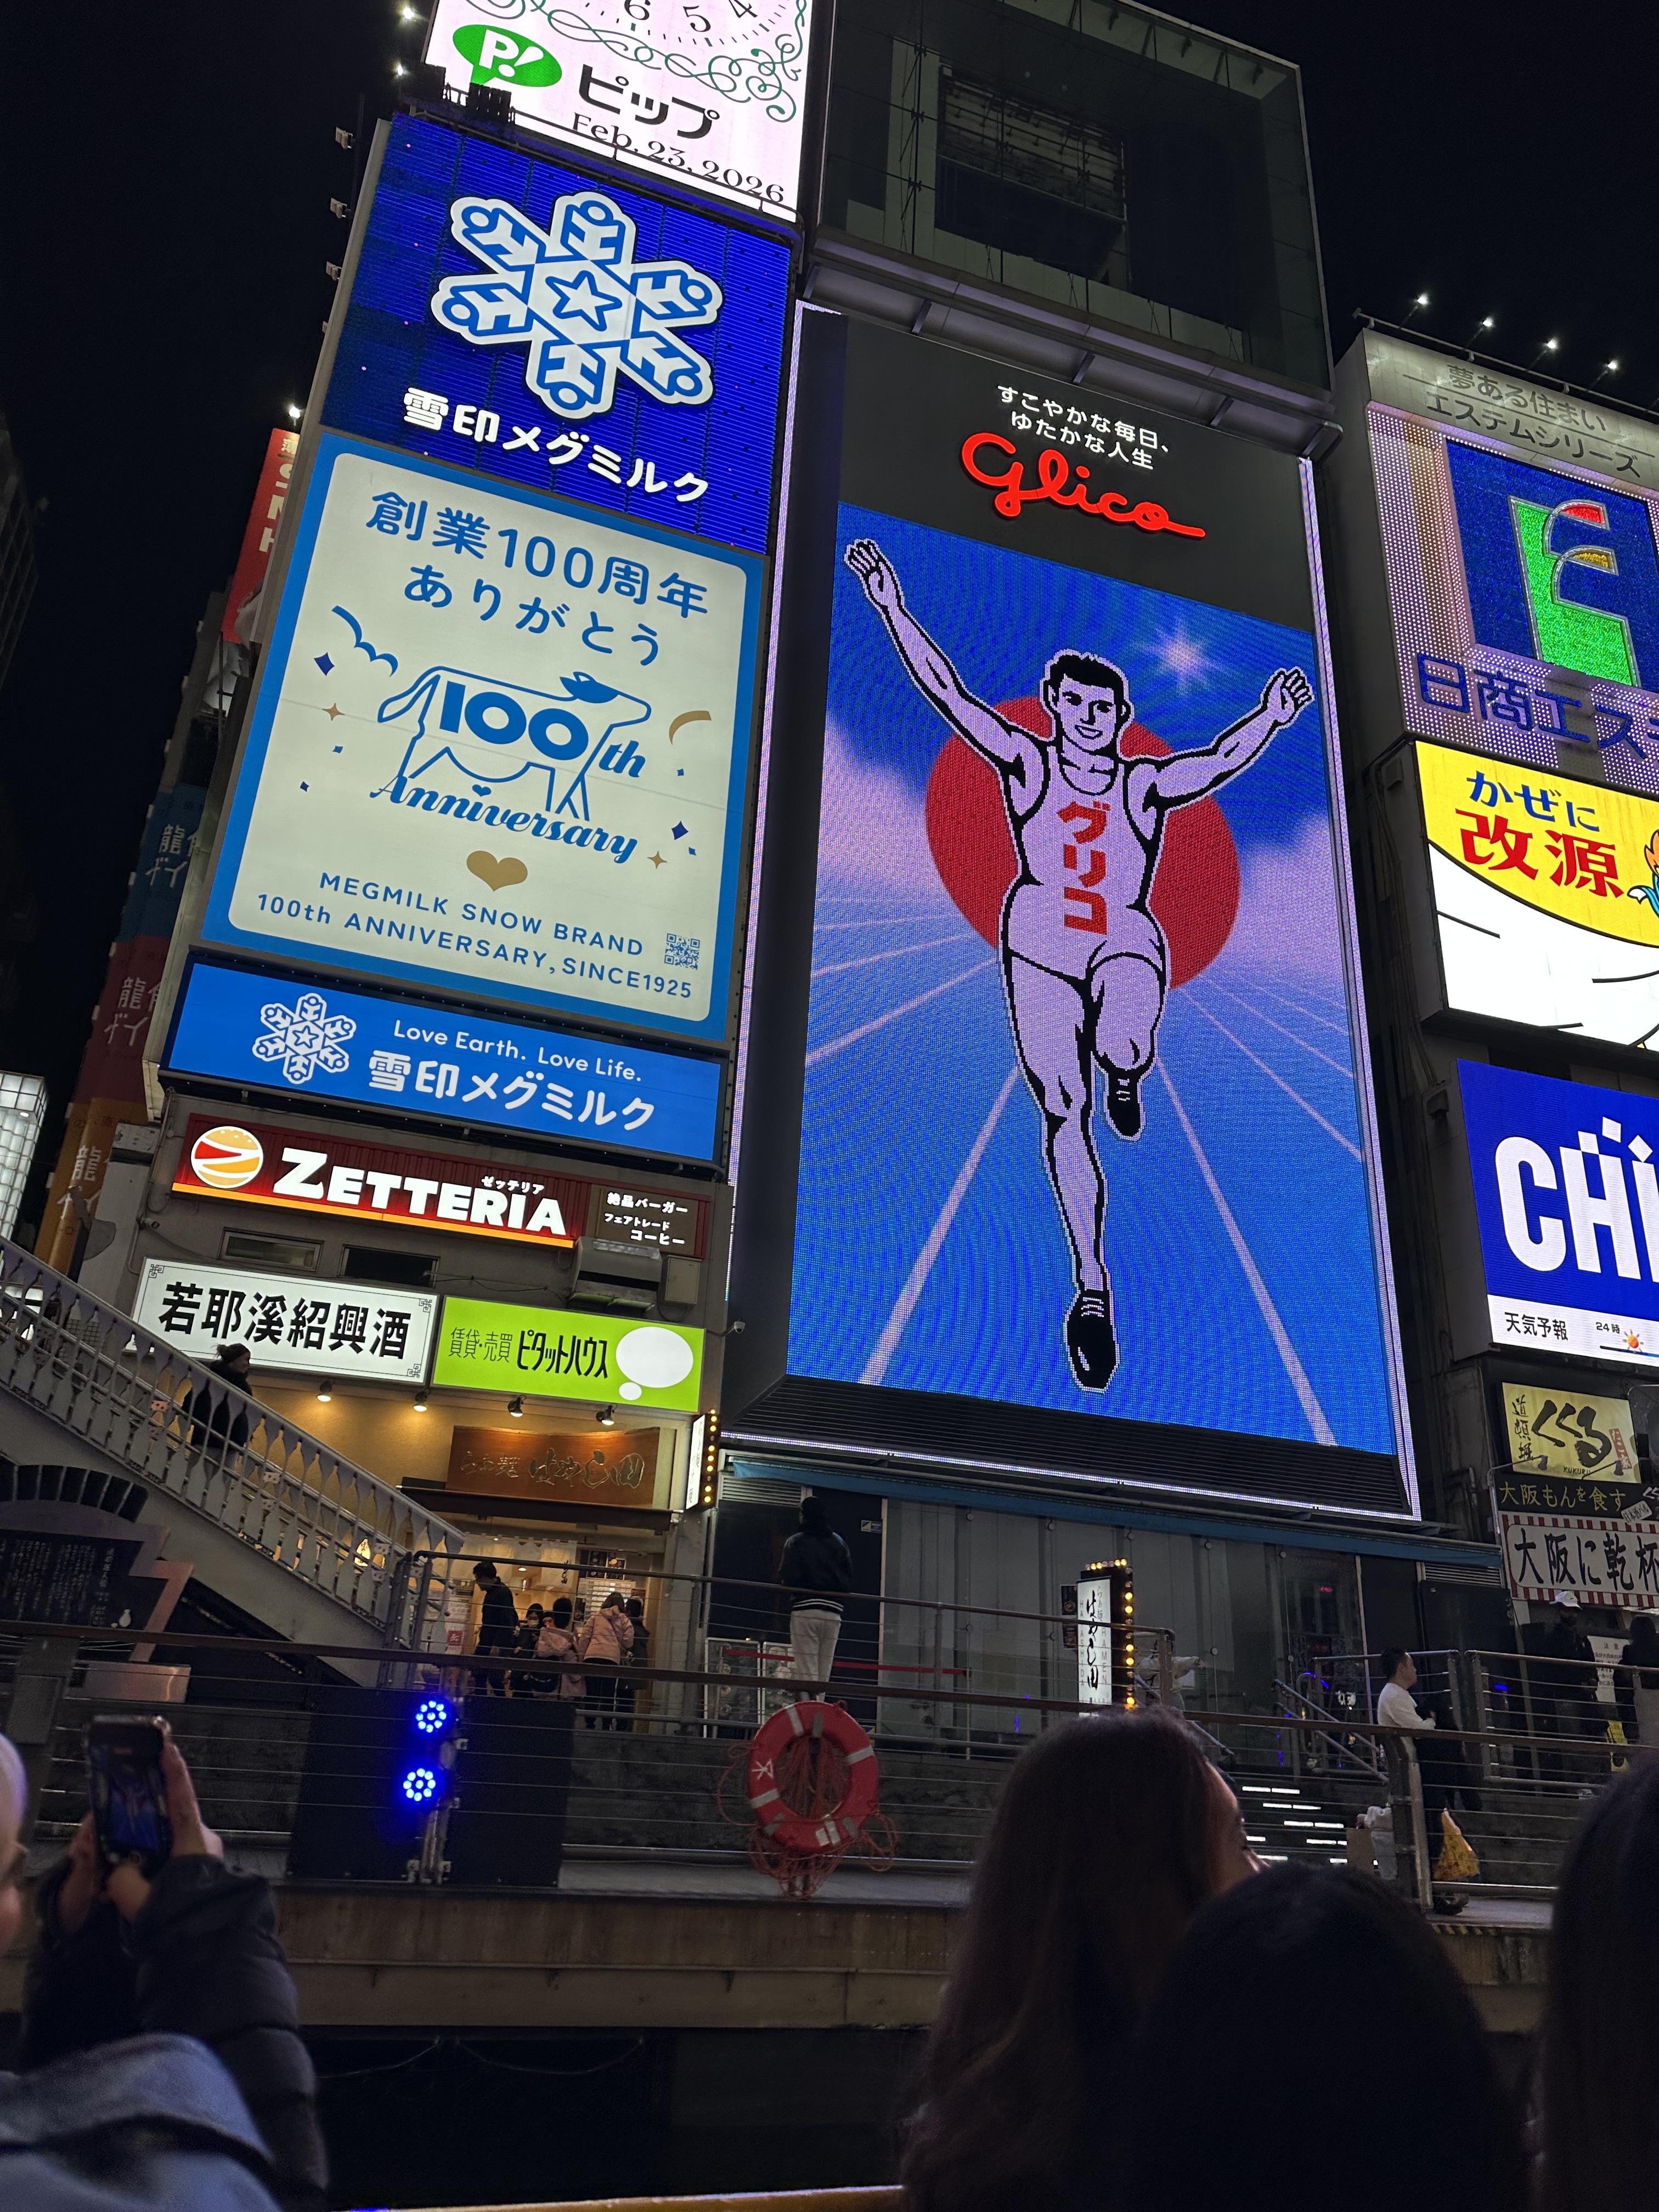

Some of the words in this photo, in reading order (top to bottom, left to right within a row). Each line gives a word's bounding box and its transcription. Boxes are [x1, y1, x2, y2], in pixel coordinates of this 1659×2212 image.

[683, 5, 711, 32] 5
[578, 64, 720, 139] ピップ
[702, 159, 785, 203] 2026
[997, 385, 1170, 453] すこやかな毎日、
[1447, 364, 1606, 432] 夢ある住まい
[404, 387, 709, 502] 雪印メグミルク
[1011, 410, 1154, 470] ゆたかな人生
[1426, 391, 1640, 478] エステムシリーズ
[961, 431, 1206, 539] Glico
[366, 491, 708, 618] 創業100周年
[404, 565, 659, 667] ありがとう
[1417, 652, 1659, 759] 日商エス
[369, 775, 637, 865] Anniversary
[1466, 770, 1600, 832] かぜに
[1057, 800, 1110, 935] グリコ
[1454, 808, 1625, 899] 改源
[257, 893, 332, 926] 100th
[320, 872, 450, 916] MEGMILK
[461, 903, 542, 935] SNOW
[554, 923, 644, 957] BRAND
[394, 1019, 448, 1046] Love
[455, 1031, 527, 1062] Earth.
[538, 1046, 589, 1071] Love
[596, 1057, 643, 1082] Life.
[368, 1050, 655, 1131] 雪印メグミルク
[272, 1147, 567, 1237] ZETTERIA
[481, 1174, 545, 1195] ゼッテリア
[607, 1192, 689, 1214] 絶品バーガー
[604, 1212, 670, 1231] フェアトレード
[630, 1229, 685, 1245] コーヒー
[448, 1327, 513, 1363] 賃貸・売買
[516, 1329, 608, 1379] ピタットハウス
[1504, 1312, 1568, 1341] 天気予報
[1595, 1322, 1621, 1334] 24時
[1531, 1399, 1612, 1468] くくる
[528, 1447, 646, 1490] はやし田
[1499, 1481, 1626, 1512] 大阪もんを食す
[1514, 1527, 1659, 1594] 大阪に乾杯
